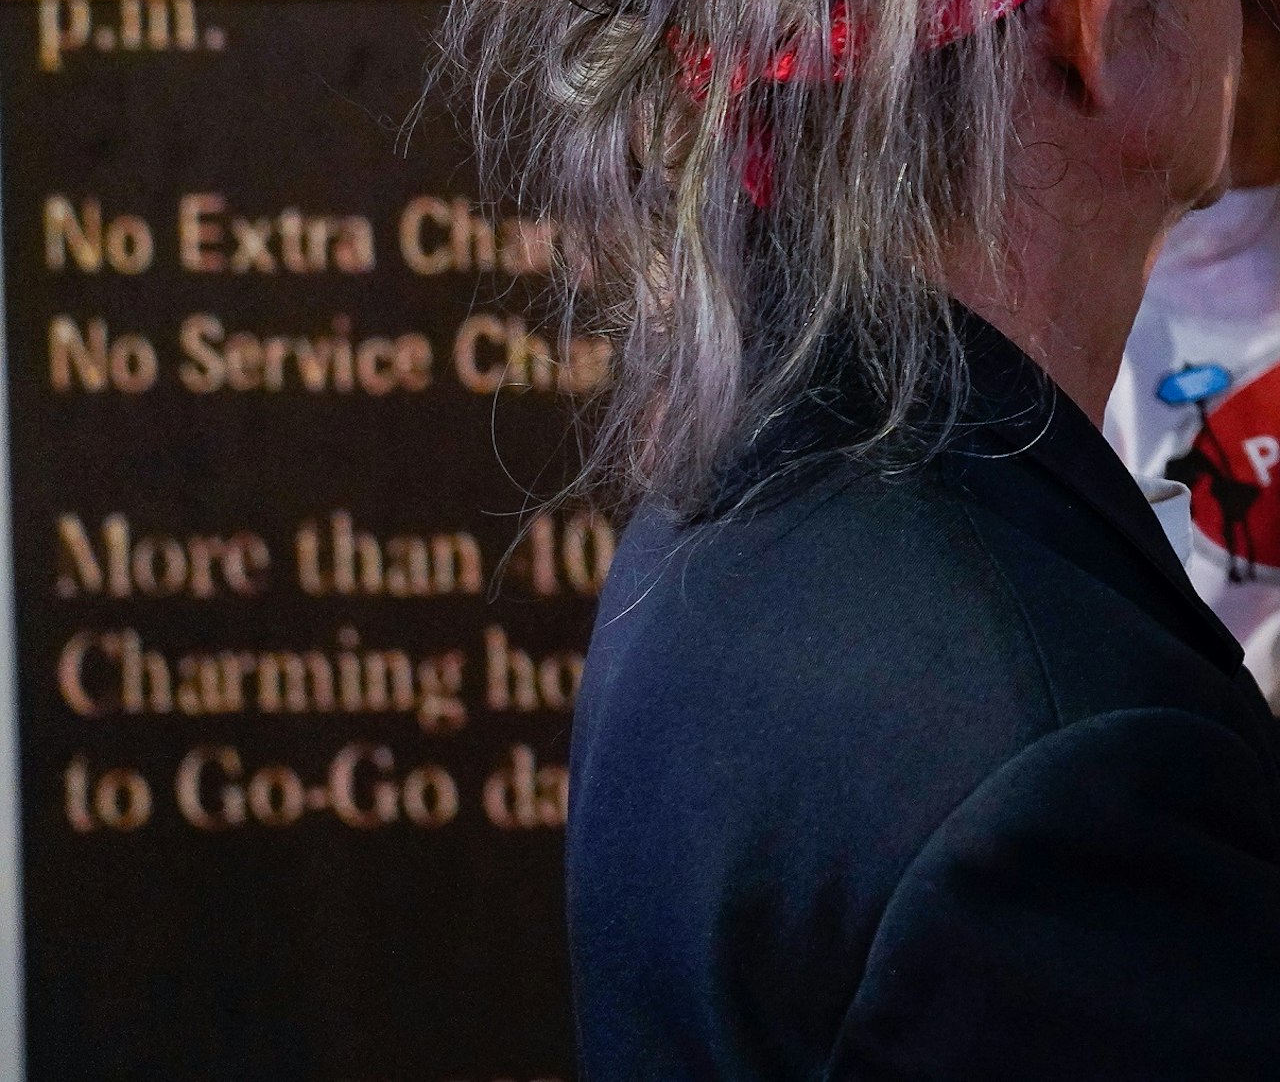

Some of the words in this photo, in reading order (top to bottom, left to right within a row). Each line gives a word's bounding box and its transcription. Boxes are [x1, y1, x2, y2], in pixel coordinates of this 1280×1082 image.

[43, 193, 155, 275] No
[179, 193, 377, 274] Extra
[49, 316, 158, 393] No
[179, 314, 433, 395] Service
[55, 510, 271, 599] More
[295, 508, 482, 597] than
[58, 625, 468, 734] Charming
[64, 753, 154, 832] to
[176, 741, 460, 830] Go-Go
